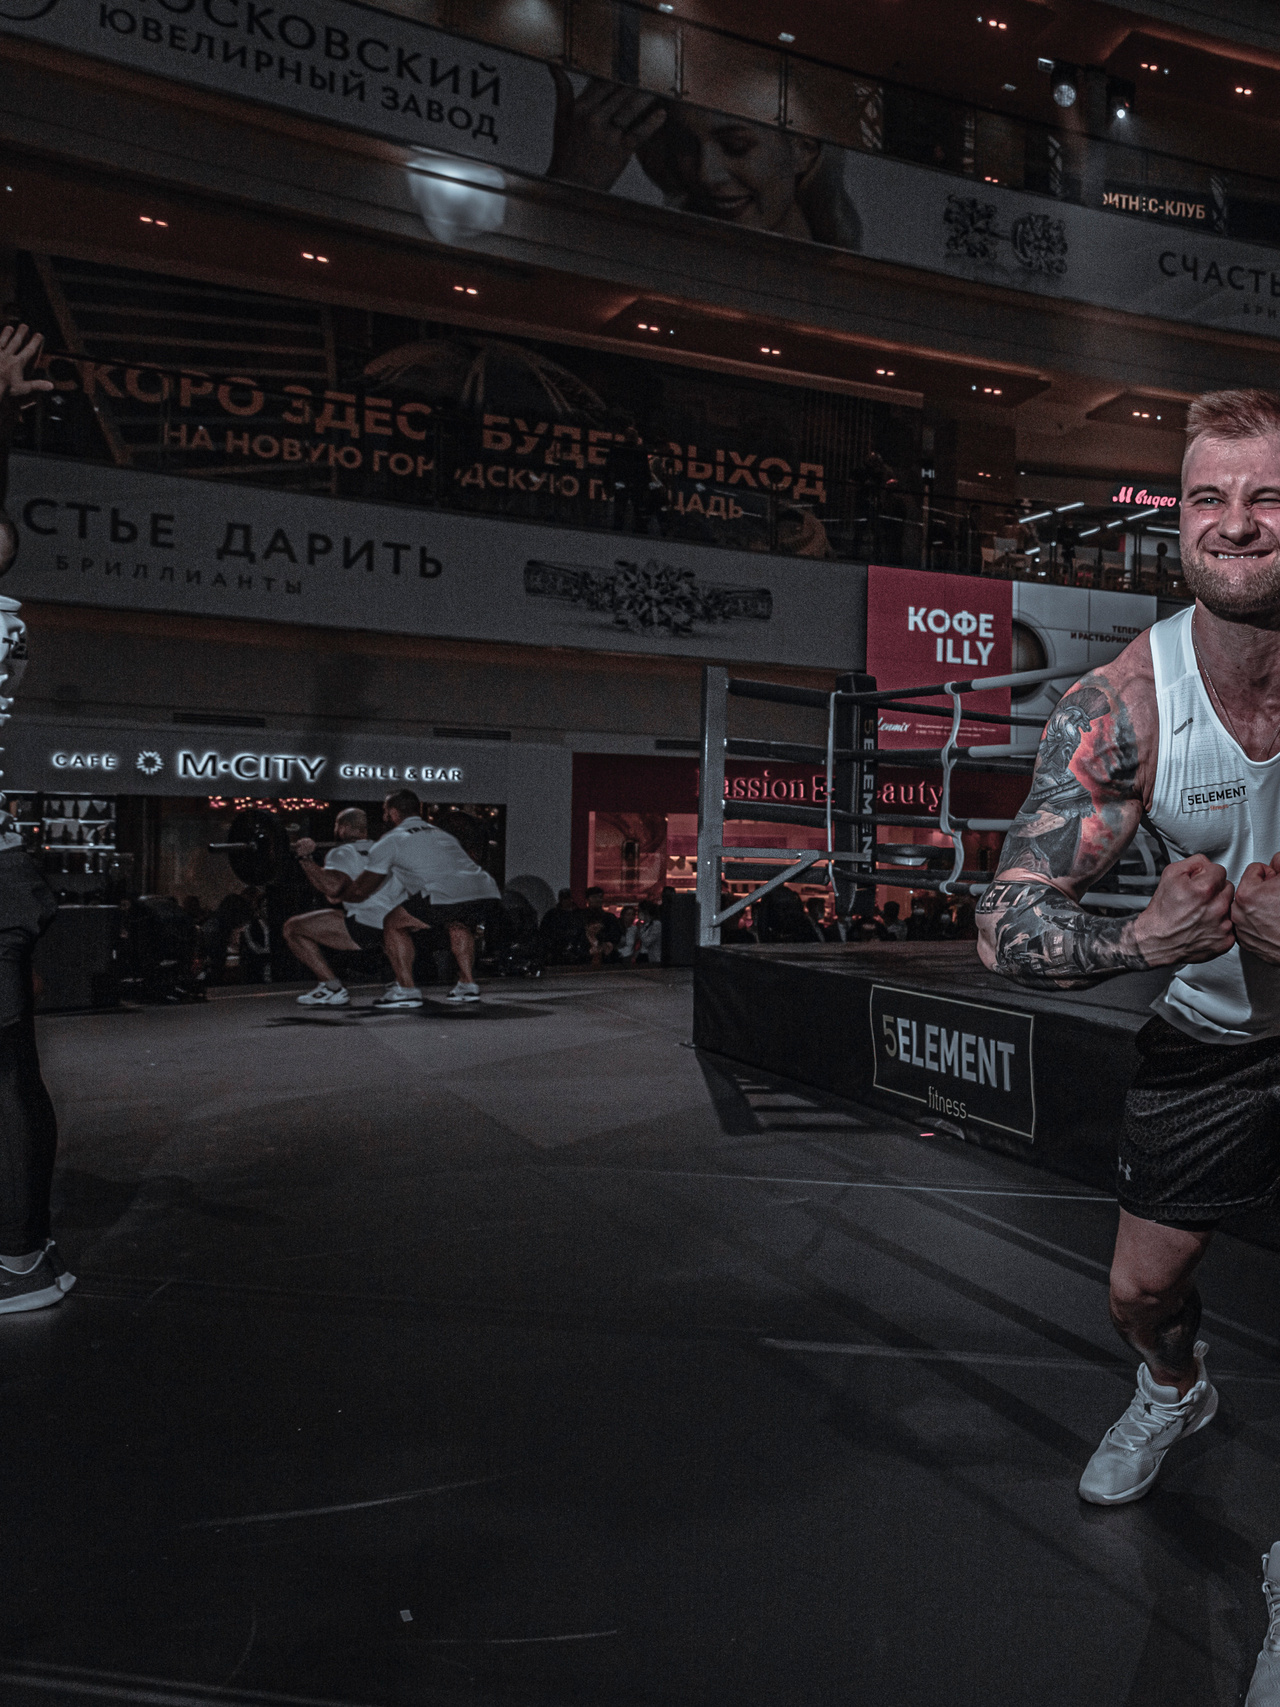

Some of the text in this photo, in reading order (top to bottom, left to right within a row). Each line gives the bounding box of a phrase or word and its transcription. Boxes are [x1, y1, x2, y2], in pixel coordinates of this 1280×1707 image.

[156, 0, 500, 106] СКОВСКИЙ
[100, 8, 499, 144] ЮВЕЛИРНЫЙ ЗАВОД
[164, 422, 214, 451] НА
[225, 430, 363, 469] НОВУЮ
[282, 384, 433, 441] ЗДЕС
[482, 413, 626, 470] БУДЕ
[23, 499, 443, 579] СТЬЕ ДАРИТЬ
[56, 554, 302, 594] БРИЛЛИАНТЫ
[908, 606, 995, 640] КОФЕ
[936, 637, 995, 667] ILLY
[341, 765, 398, 779] GRILL
[424, 768, 463, 781] BAR
[697, 768, 806, 802] assion
[1187, 785, 1246, 806] 5ELEMENT
[882, 1014, 1015, 1092] 5ELEMENT
[928, 1086, 967, 1119] fitness
